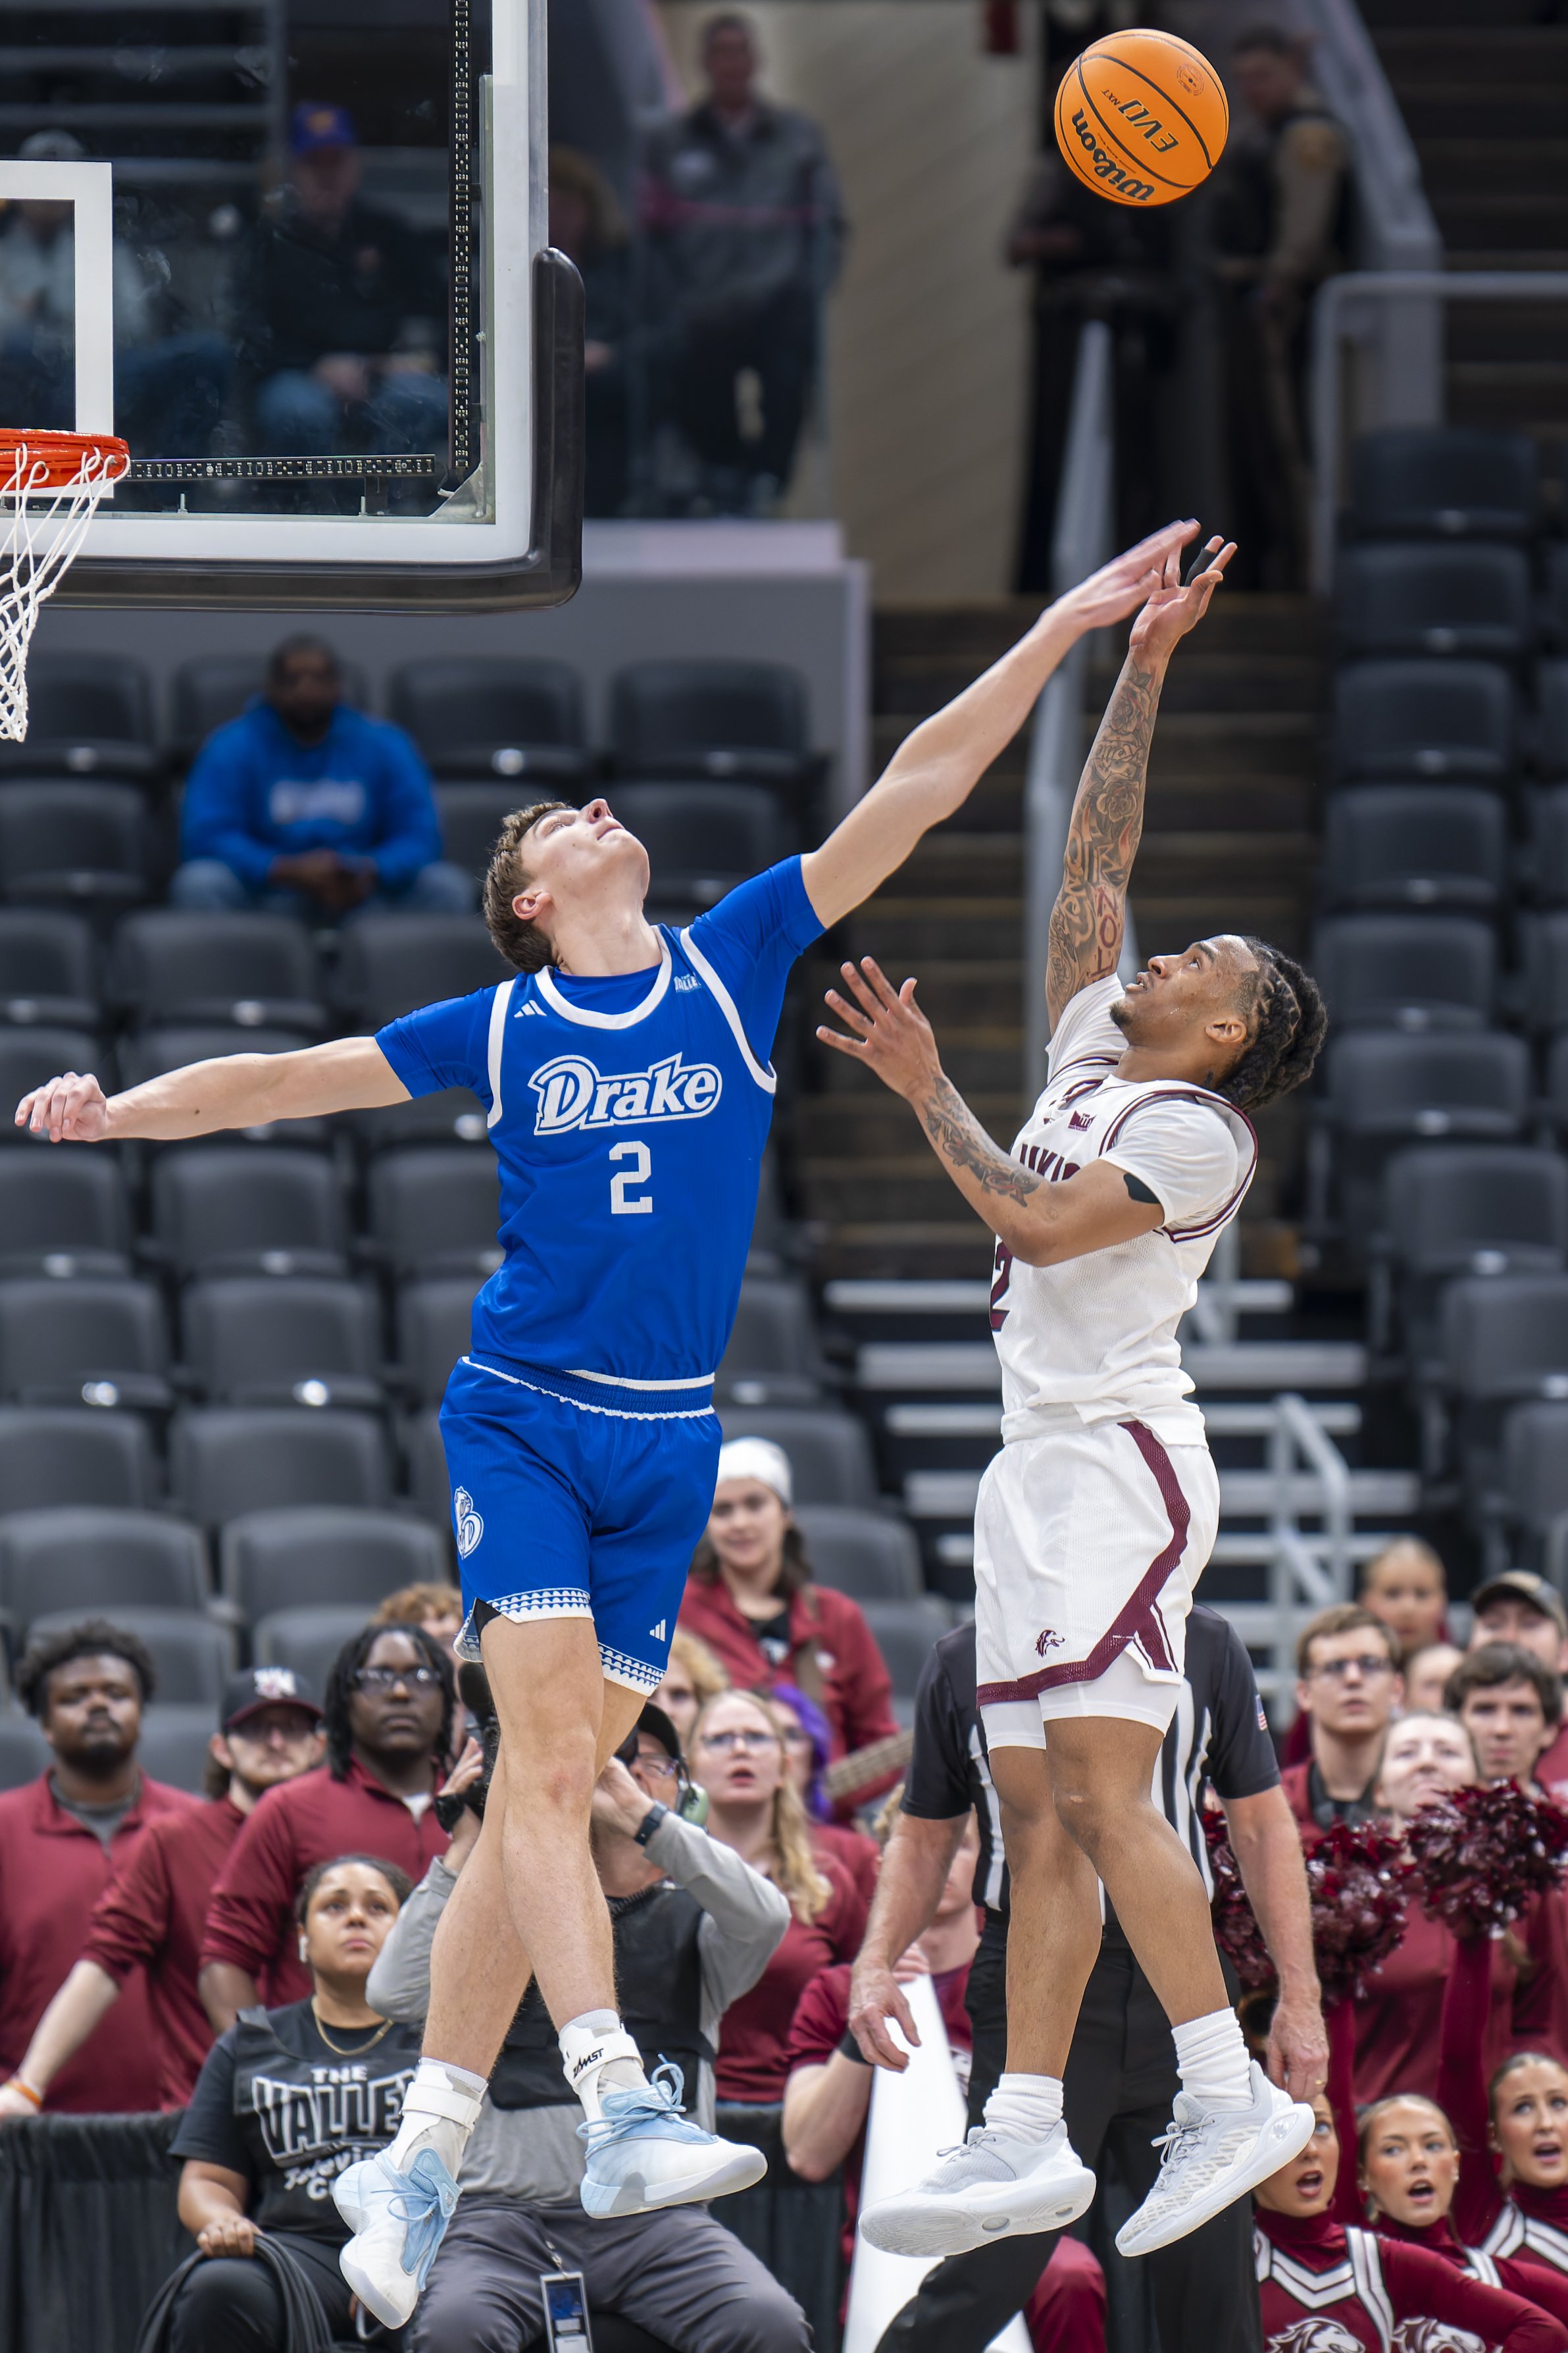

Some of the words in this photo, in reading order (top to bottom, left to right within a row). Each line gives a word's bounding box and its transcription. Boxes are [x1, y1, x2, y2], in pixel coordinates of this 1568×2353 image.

[1101, 88, 1121, 107] NXT
[1071, 108, 1155, 201] Wilson
[528, 1052, 722, 1135] Drake
[609, 1141, 652, 1214] 2
[990, 1241, 1013, 1332] 2
[311, 2065, 368, 2084] THE
